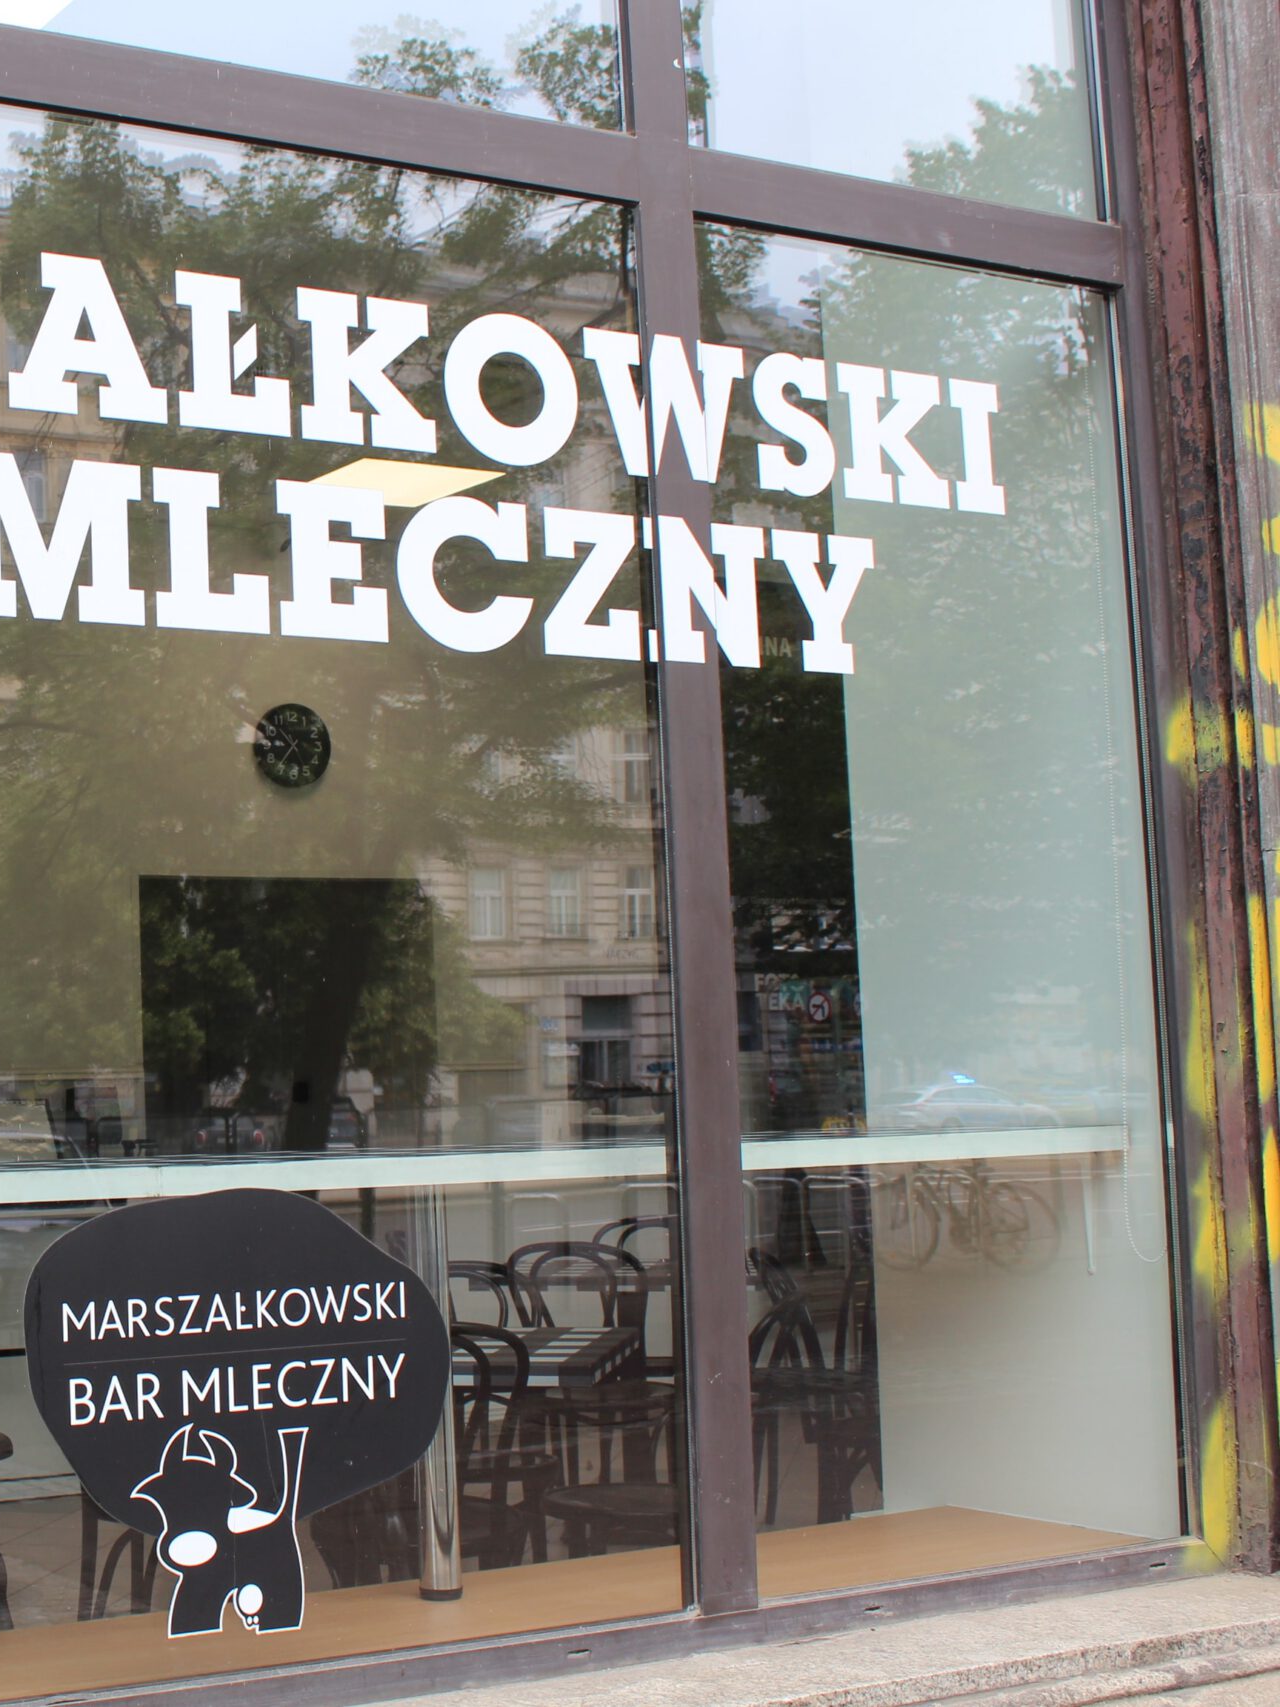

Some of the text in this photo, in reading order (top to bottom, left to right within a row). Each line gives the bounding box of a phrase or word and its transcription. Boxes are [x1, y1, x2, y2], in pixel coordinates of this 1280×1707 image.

[61, 1280, 407, 1343] MARSZAŁKOWSKI
[68, 1353, 407, 1427] BAR MLECZNY
